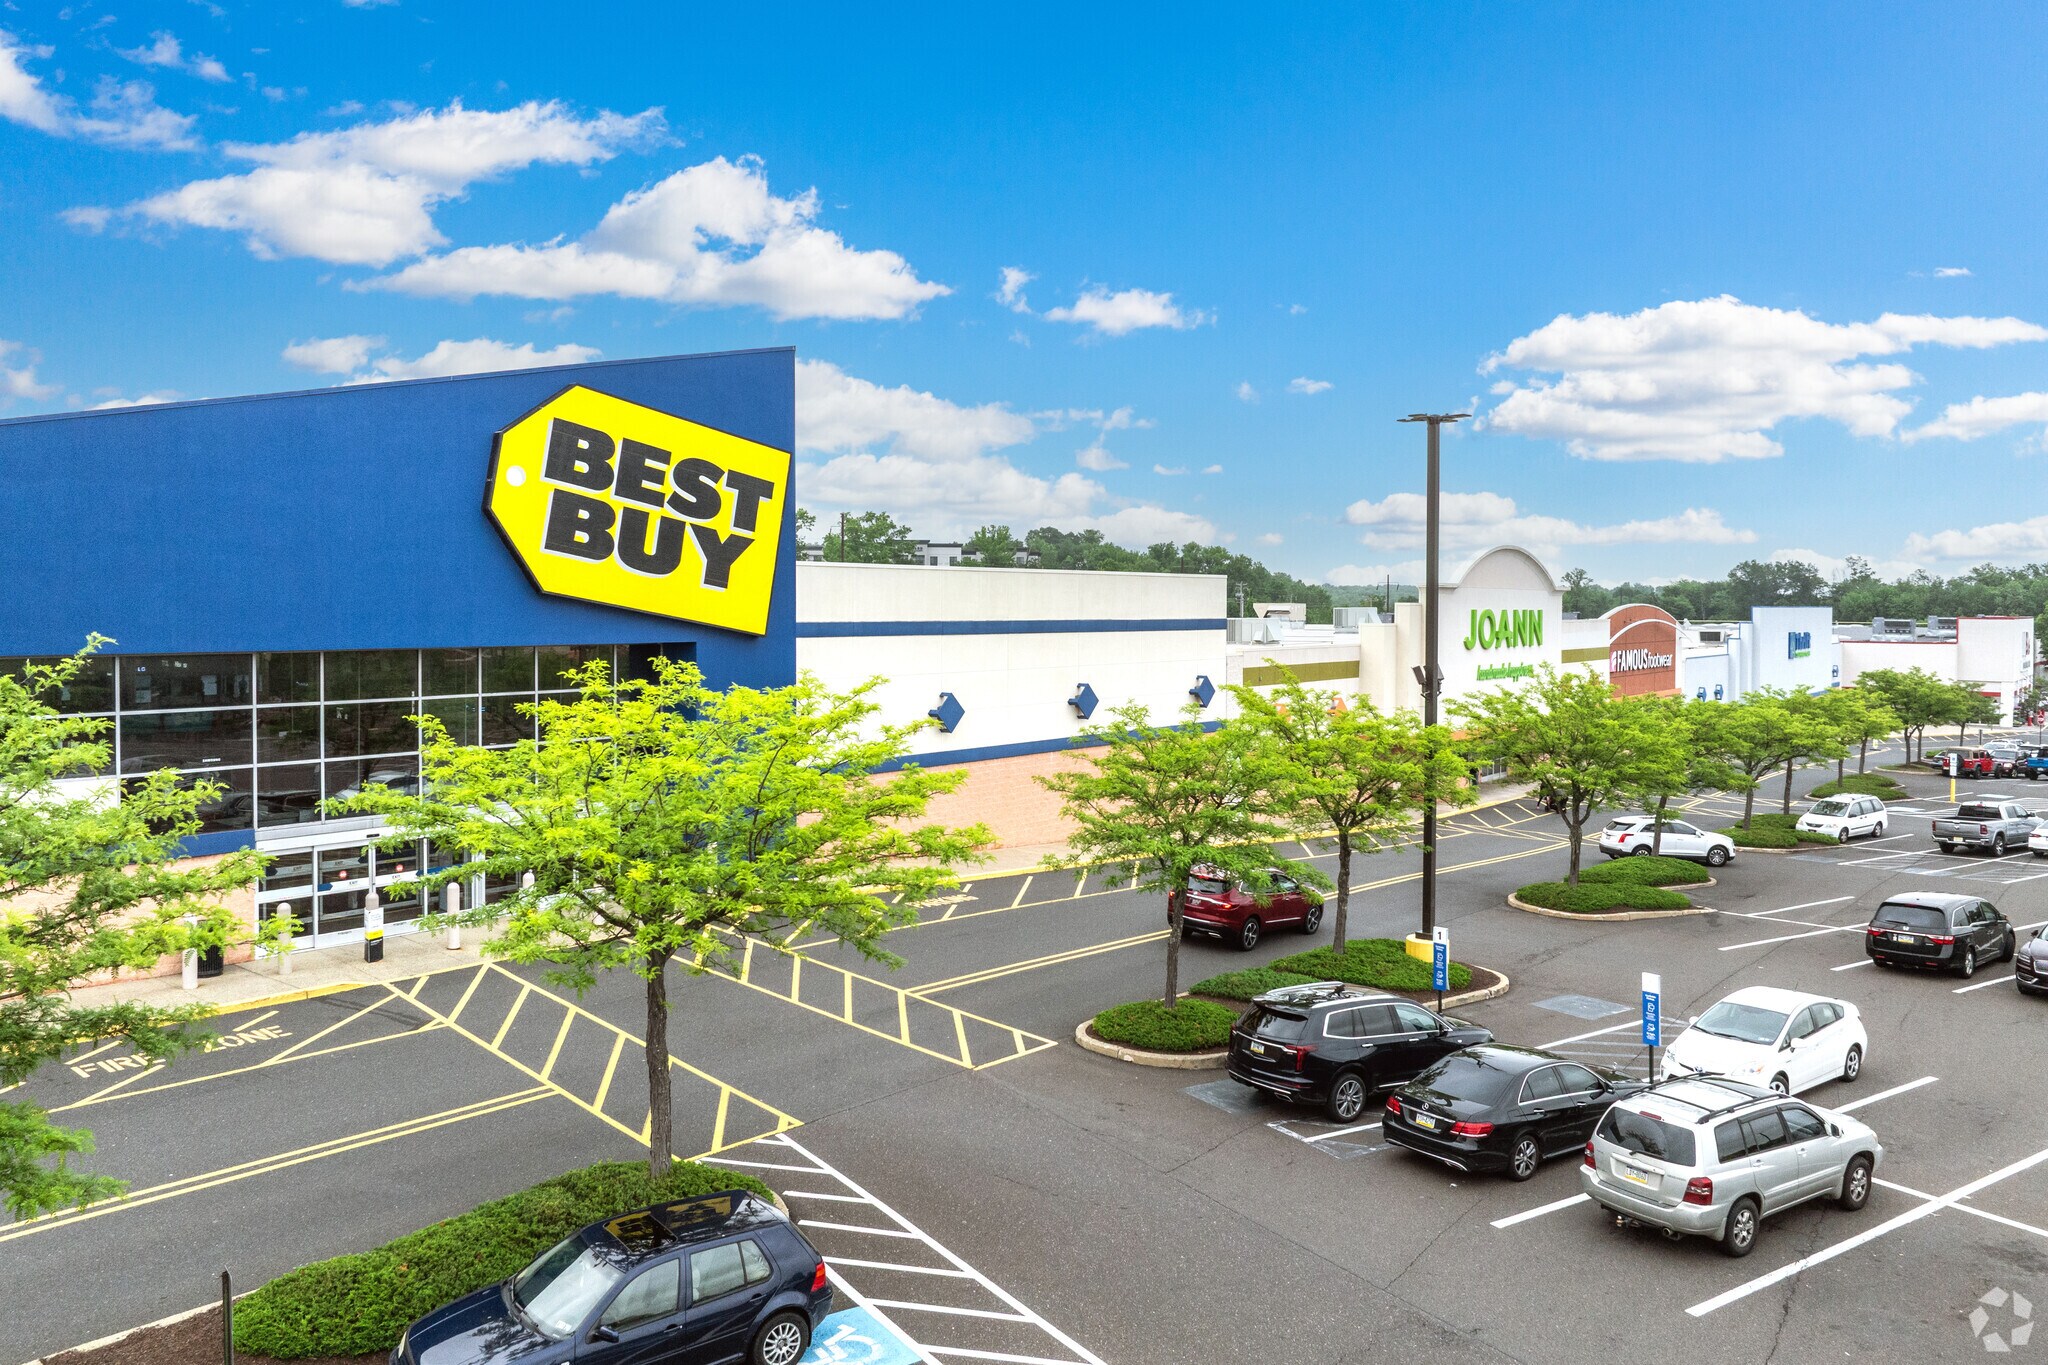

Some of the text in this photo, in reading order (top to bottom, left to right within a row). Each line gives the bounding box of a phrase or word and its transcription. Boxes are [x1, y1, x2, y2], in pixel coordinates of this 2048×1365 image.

[541, 417, 774, 533] BEST
[541, 488, 755, 591] BUY
[1463, 608, 1543, 650] JOANN
[1617, 649, 1673, 671] FAMOUS footwear
[1437, 931, 1442, 940] 1
[70, 1053, 166, 1079] FIRE
